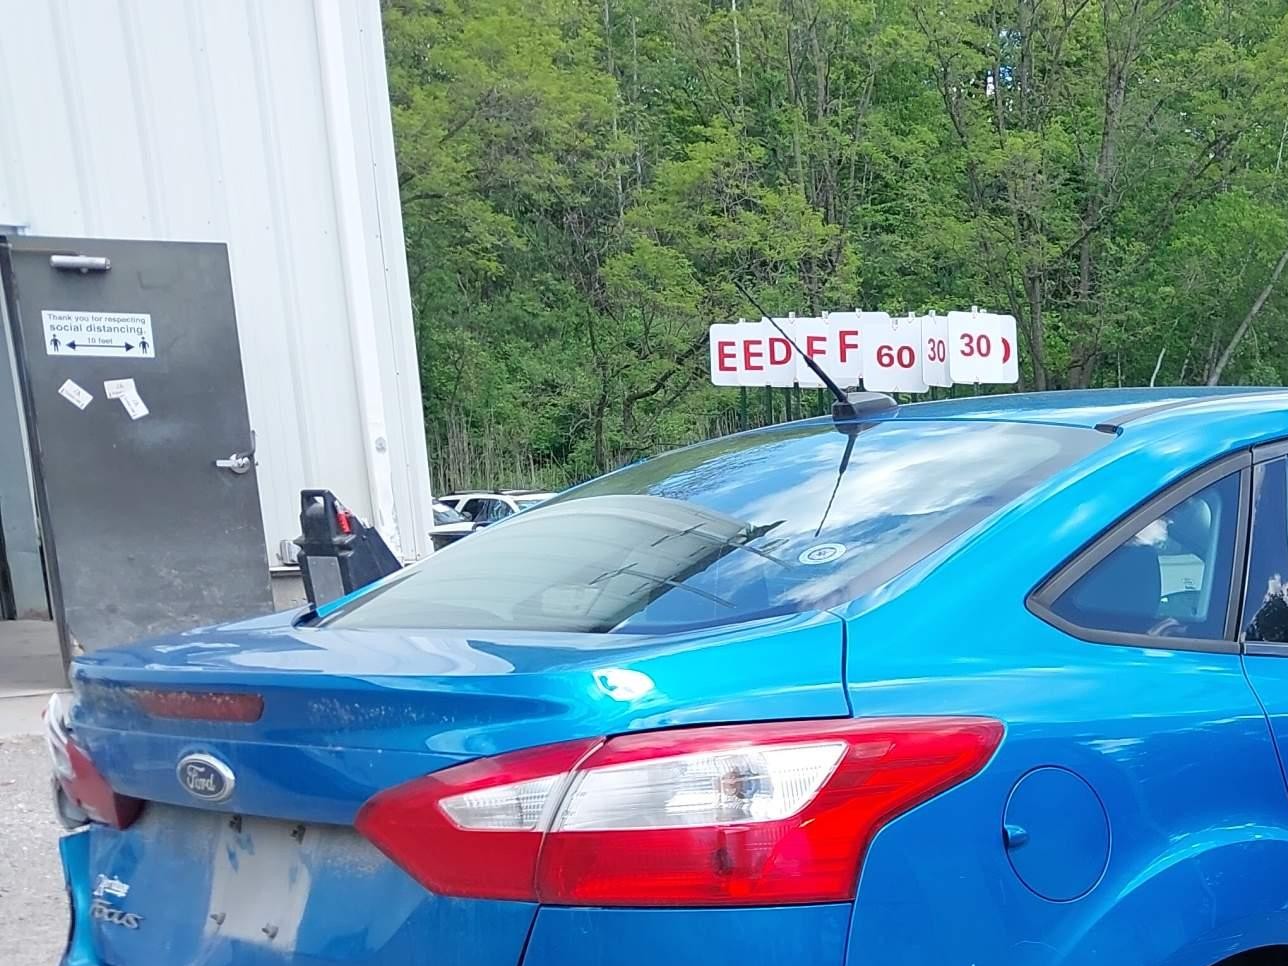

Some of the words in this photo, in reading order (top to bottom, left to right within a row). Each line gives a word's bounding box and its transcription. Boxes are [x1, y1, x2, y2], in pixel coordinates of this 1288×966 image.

[48, 313, 72, 321] Thank
[104, 316, 146, 324] respecting
[49, 323, 82, 332] social
[876, 344, 916, 369] 60
[927, 338, 946, 363] 30
